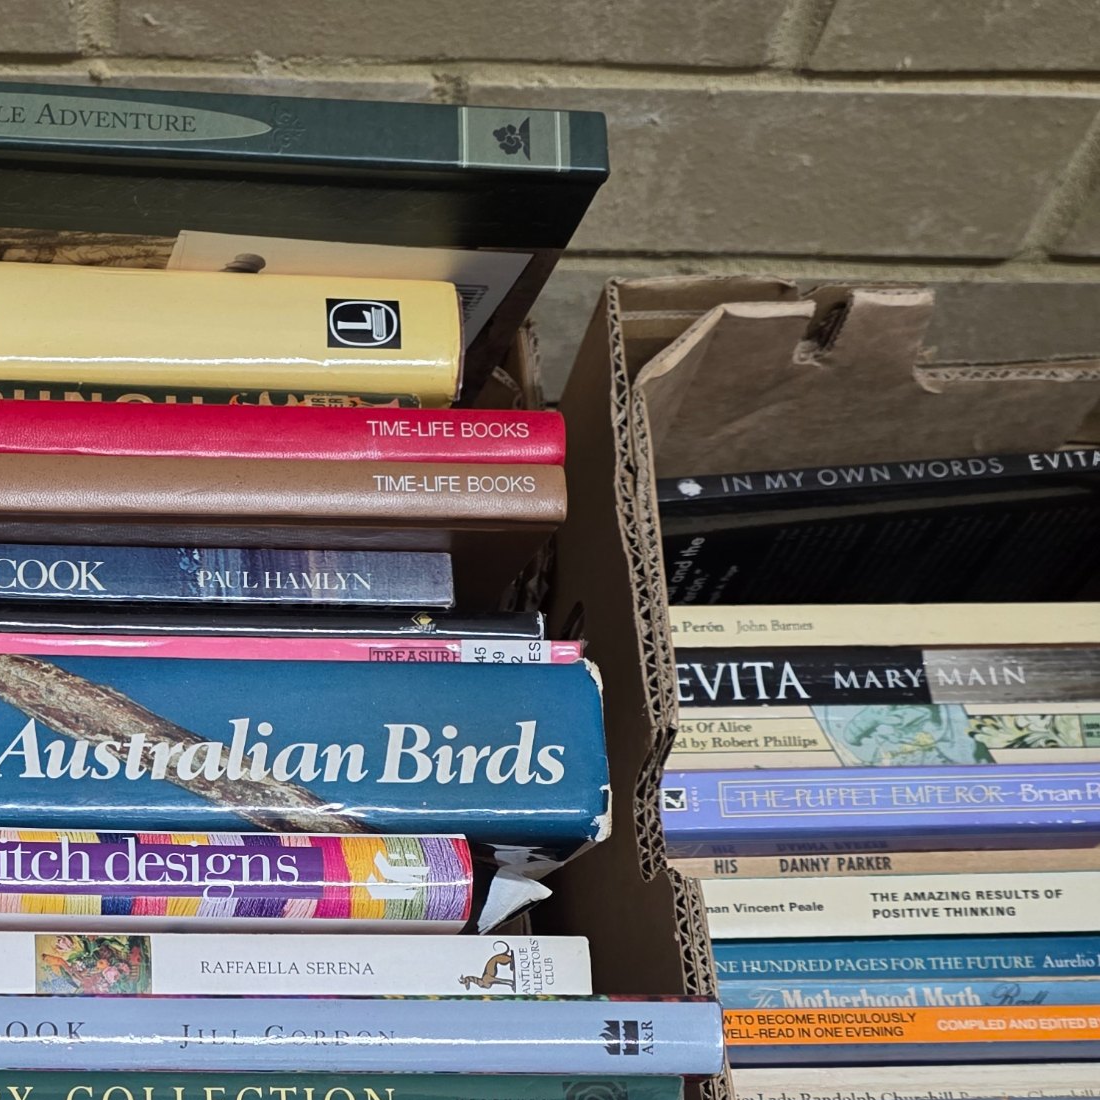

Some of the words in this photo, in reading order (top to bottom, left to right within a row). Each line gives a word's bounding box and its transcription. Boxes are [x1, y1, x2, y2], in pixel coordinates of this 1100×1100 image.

[33, 100, 197, 134] ADVENTURE
[366, 419, 455, 438] TIME-LIFE
[461, 420, 530, 440] BOOKS
[373, 474, 461, 494] TIME-LIFE
[467, 474, 536, 494] BOOKS
[721, 474, 753, 493] IN
[764, 471, 804, 491] MY
[817, 465, 891, 486] OWN
[899, 457, 1005, 481] WORDS
[197, 568, 258, 590] PAUL
[263, 570, 373, 592] HAMLYN
[736, 619, 768, 635] John
[676, 661, 812, 702] EVITA
[833, 667, 926, 691] MARY
[937, 664, 1027, 687] MAIN
[718, 721, 753, 733] Alice
[711, 736, 759, 748] Robert
[763, 735, 818, 749] Phillips
[375, 719, 566, 786] Birds
[890, 784, 1002, 805] EMPEROR
[103, 837, 299, 903] designs
[713, 858, 739, 875] HIS
[778, 856, 831, 874] DANNY
[837, 855, 893, 873] PARKER
[869, 892, 900, 903] THE
[903, 890, 973, 902] AMAZING
[975, 889, 1041, 901] RESULTS
[1044, 888, 1064, 900] OF
[733, 901, 785, 915] Vincent
[789, 901, 825, 915] Peale
[872, 907, 940, 919] POSITIVE
[944, 906, 1017, 918] THINKING
[199, 961, 300, 976] RAFFAELLA
[305, 961, 374, 976] SERENA
[544, 956, 555, 986] CLUB
[741, 958, 833, 974] HUNDRED
[834, 957, 889, 972] PAGES
[890, 957, 927, 971] FOR
[926, 956, 964, 970] THE
[966, 954, 1036, 970] FUTURE
[1042, 953, 1095, 969] Aurelio
[736, 1014, 755, 1025] TO
[757, 1013, 816, 1025] BECOME
[818, 1012, 917, 1024] RIDICULOUSLY
[937, 1019, 1008, 1032] COMPILED
[1009, 1018, 1039, 1030] AND
[1039, 1017, 1088, 1030] EDITED
[814, 1027, 845, 1038] ONE
[846, 1026, 904, 1038] EVENING
